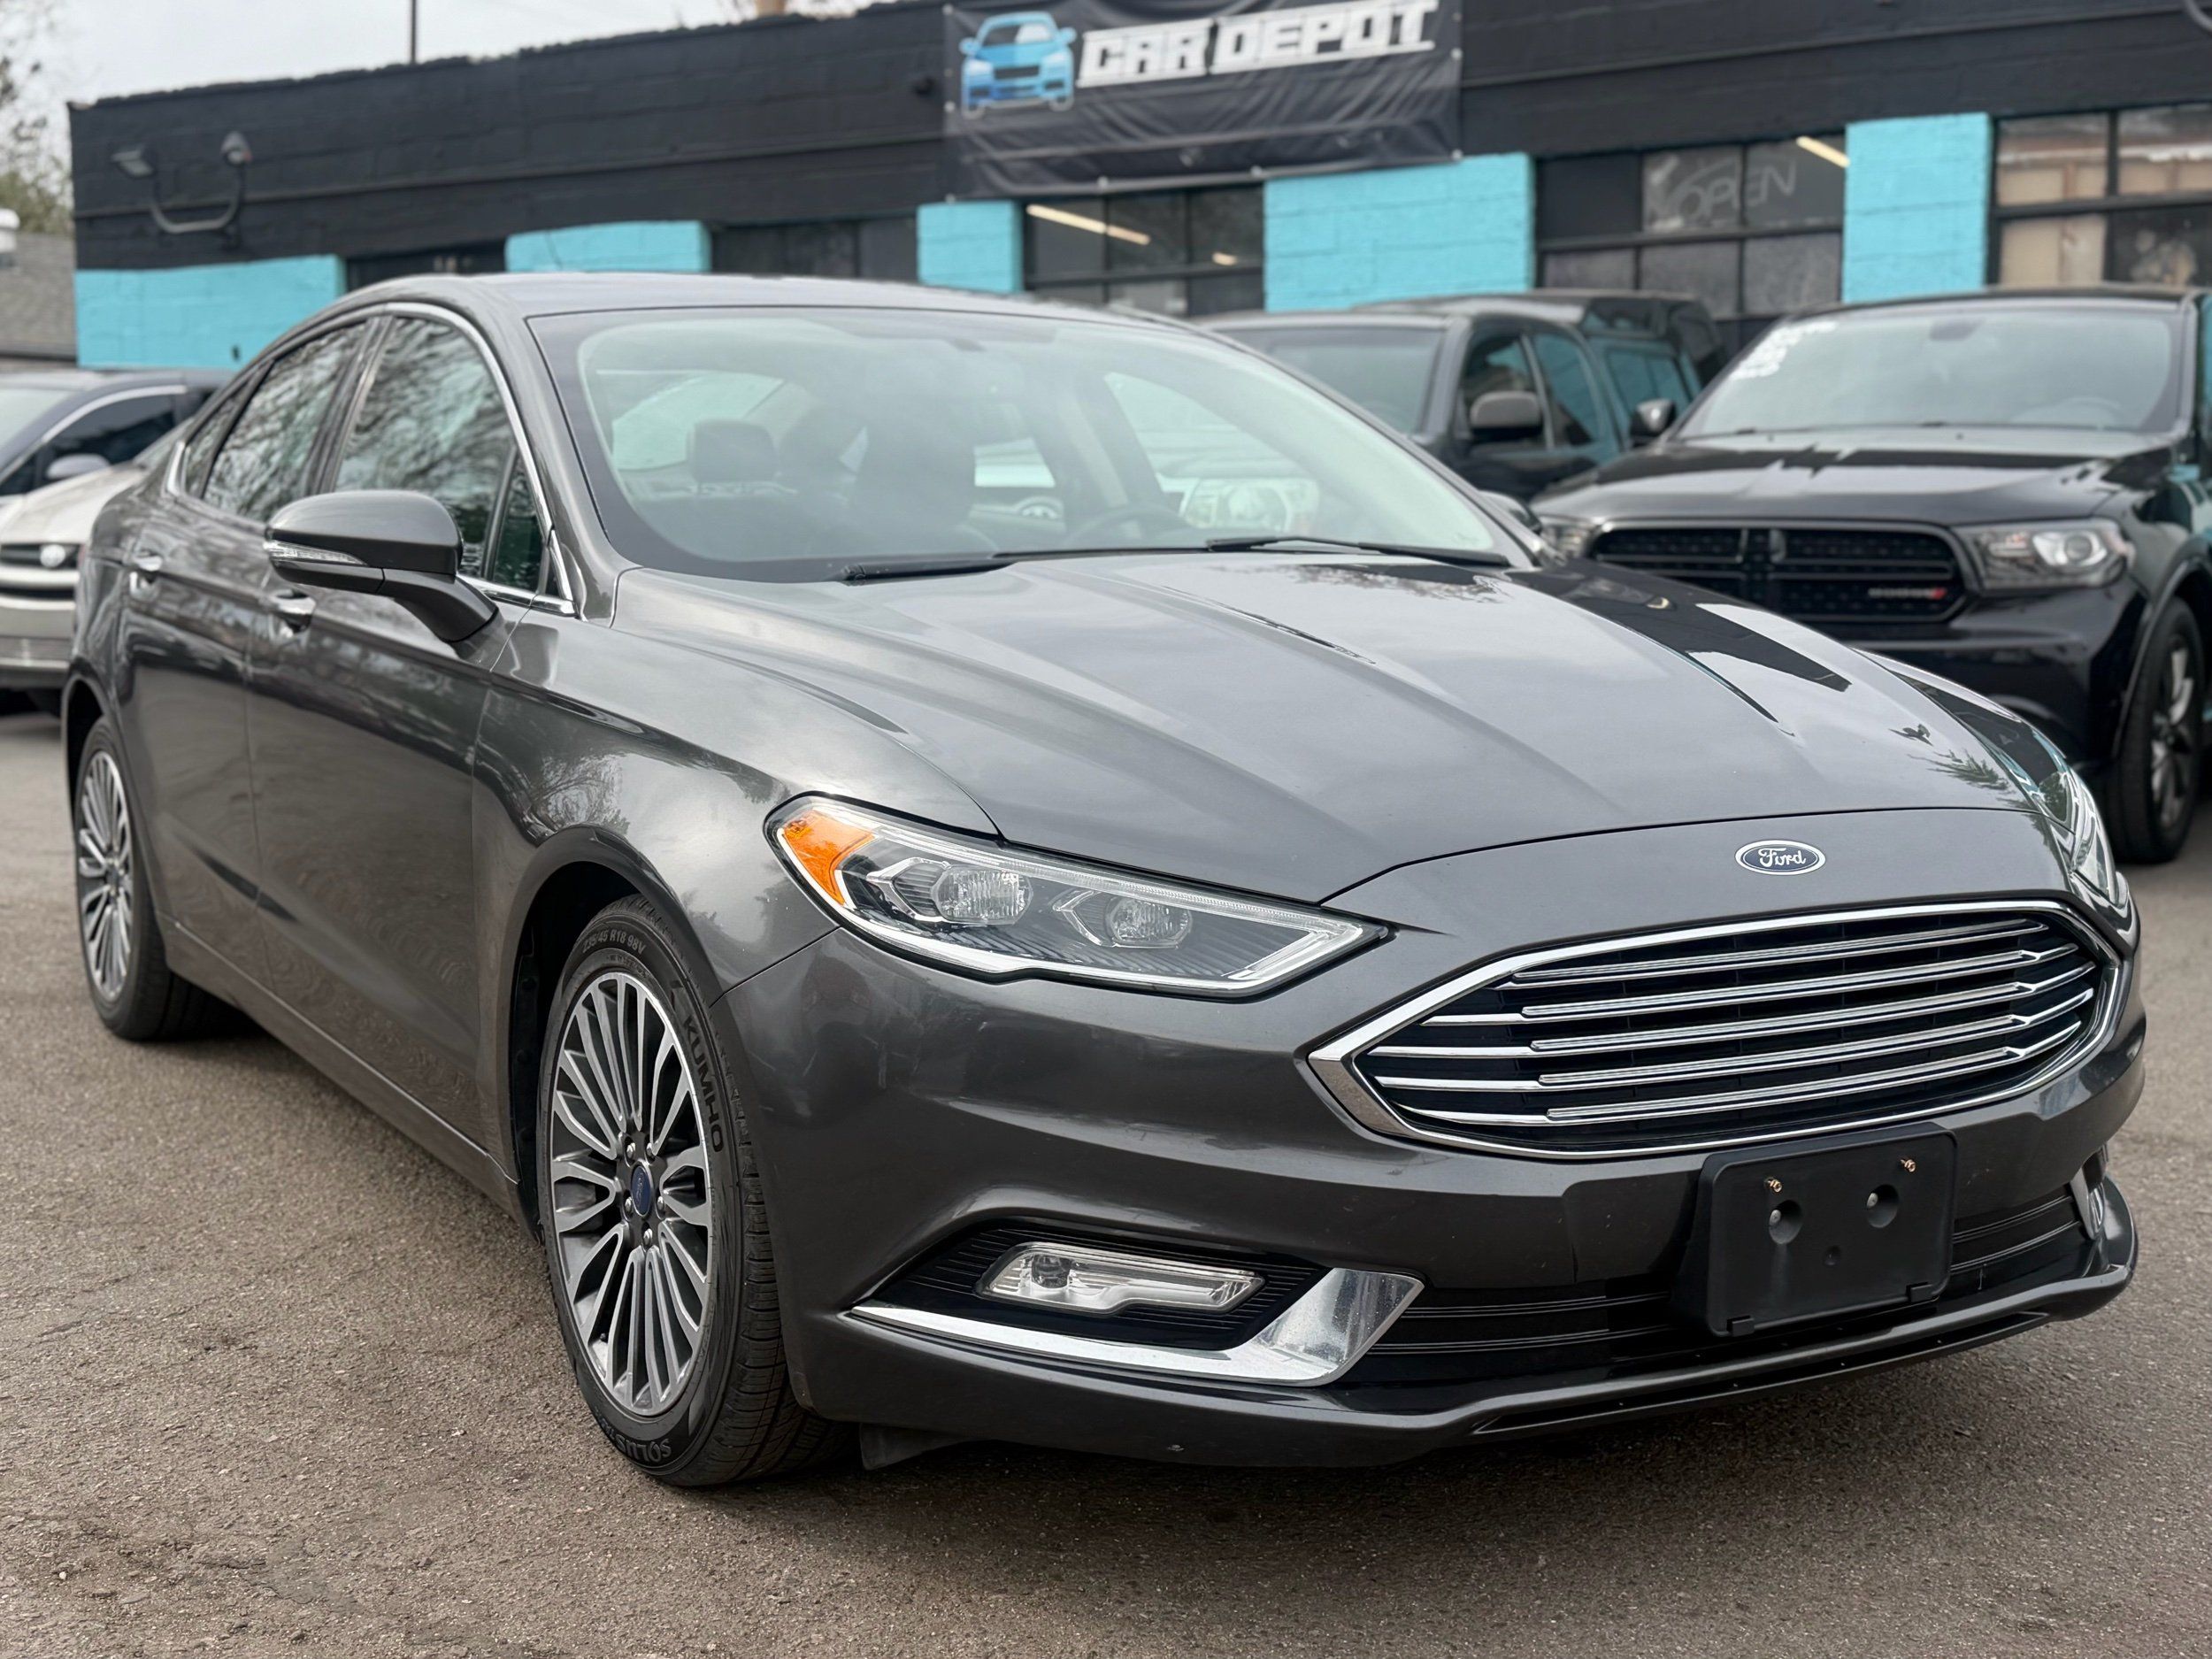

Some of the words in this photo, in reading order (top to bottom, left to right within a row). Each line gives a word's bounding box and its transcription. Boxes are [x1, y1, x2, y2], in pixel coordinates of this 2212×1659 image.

[1077, 18, 1213, 88] CAR
[1210, 0, 1439, 74] DEPOT
[1758, 847, 1807, 867] Ford
[682, 1016, 725, 1153] KUMHO
[614, 1433, 672, 1463] SOLUS
